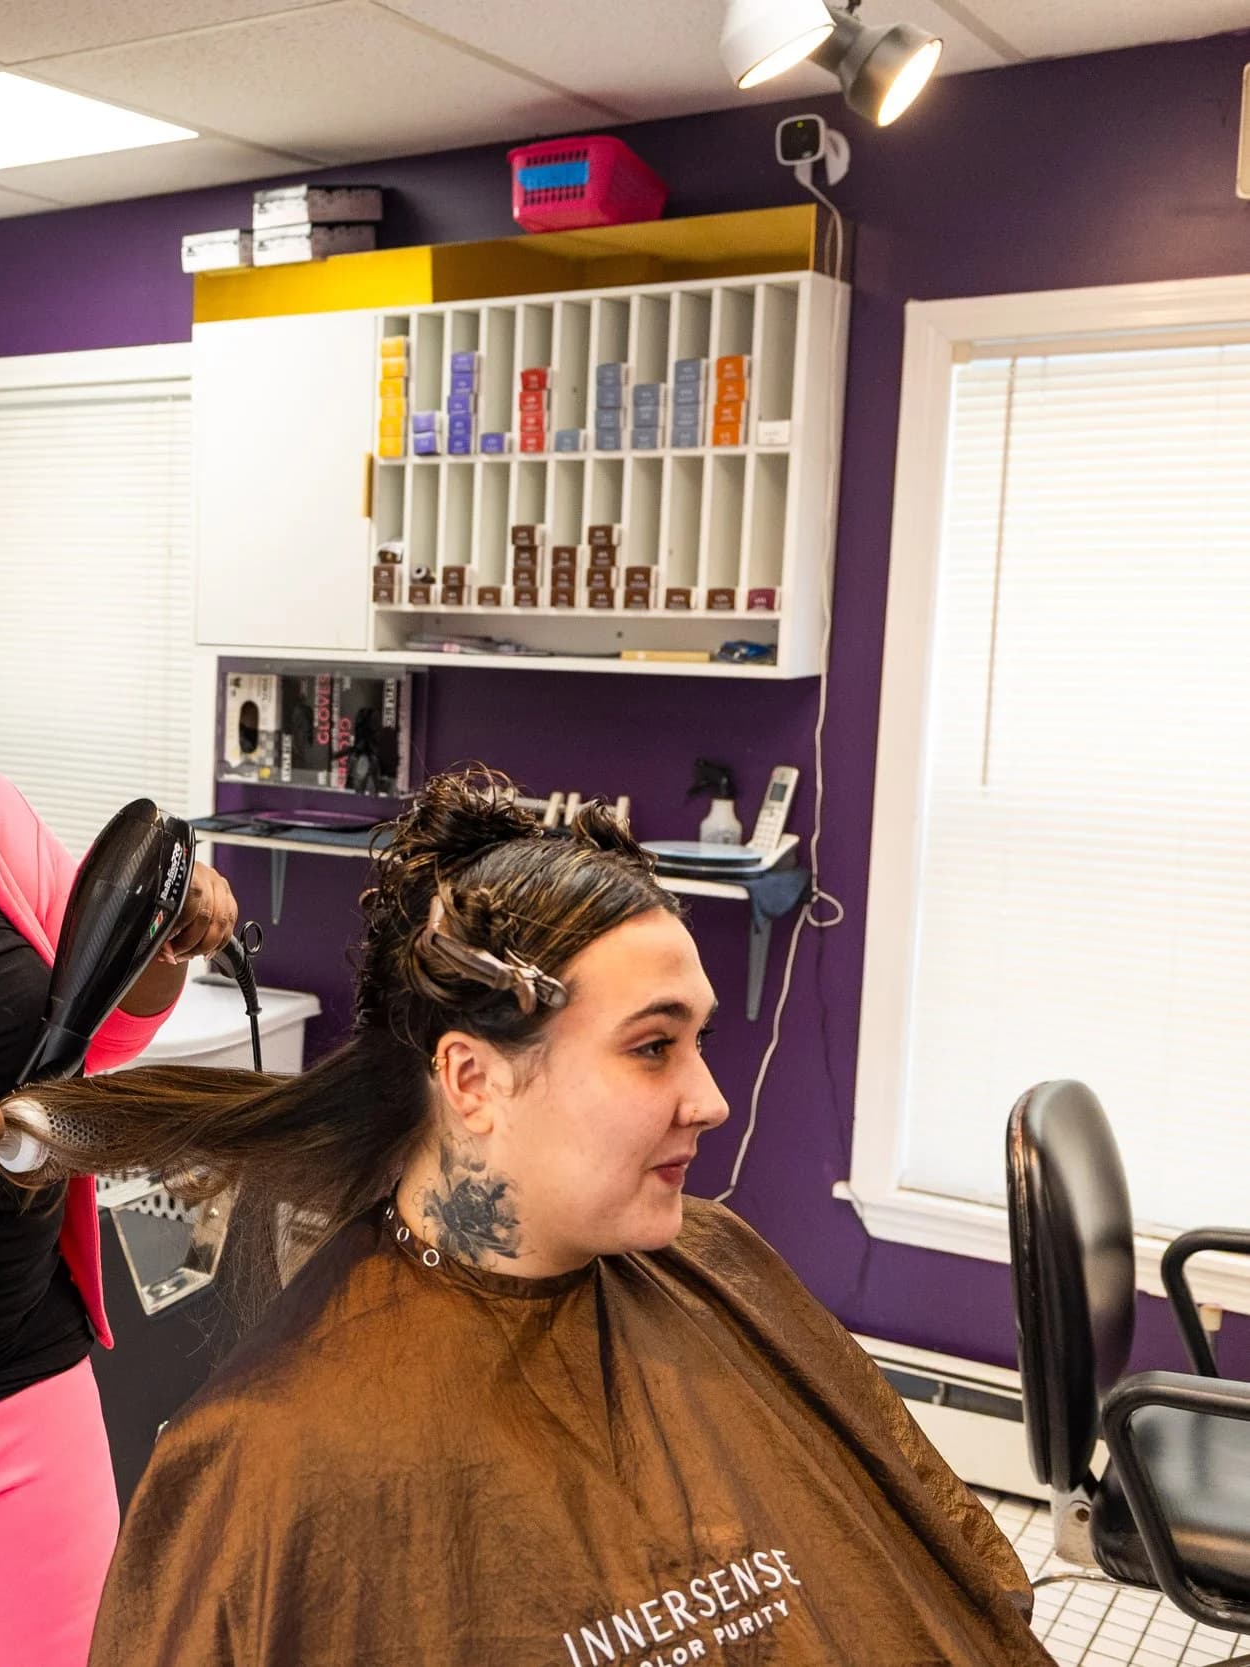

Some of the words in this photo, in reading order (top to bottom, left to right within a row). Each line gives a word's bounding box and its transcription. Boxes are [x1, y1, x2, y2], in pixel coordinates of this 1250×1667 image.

[316, 673, 331, 745] GLOVES
[563, 1549, 801, 1667] INNERSENSE
[712, 1600, 790, 1645] PURITY
